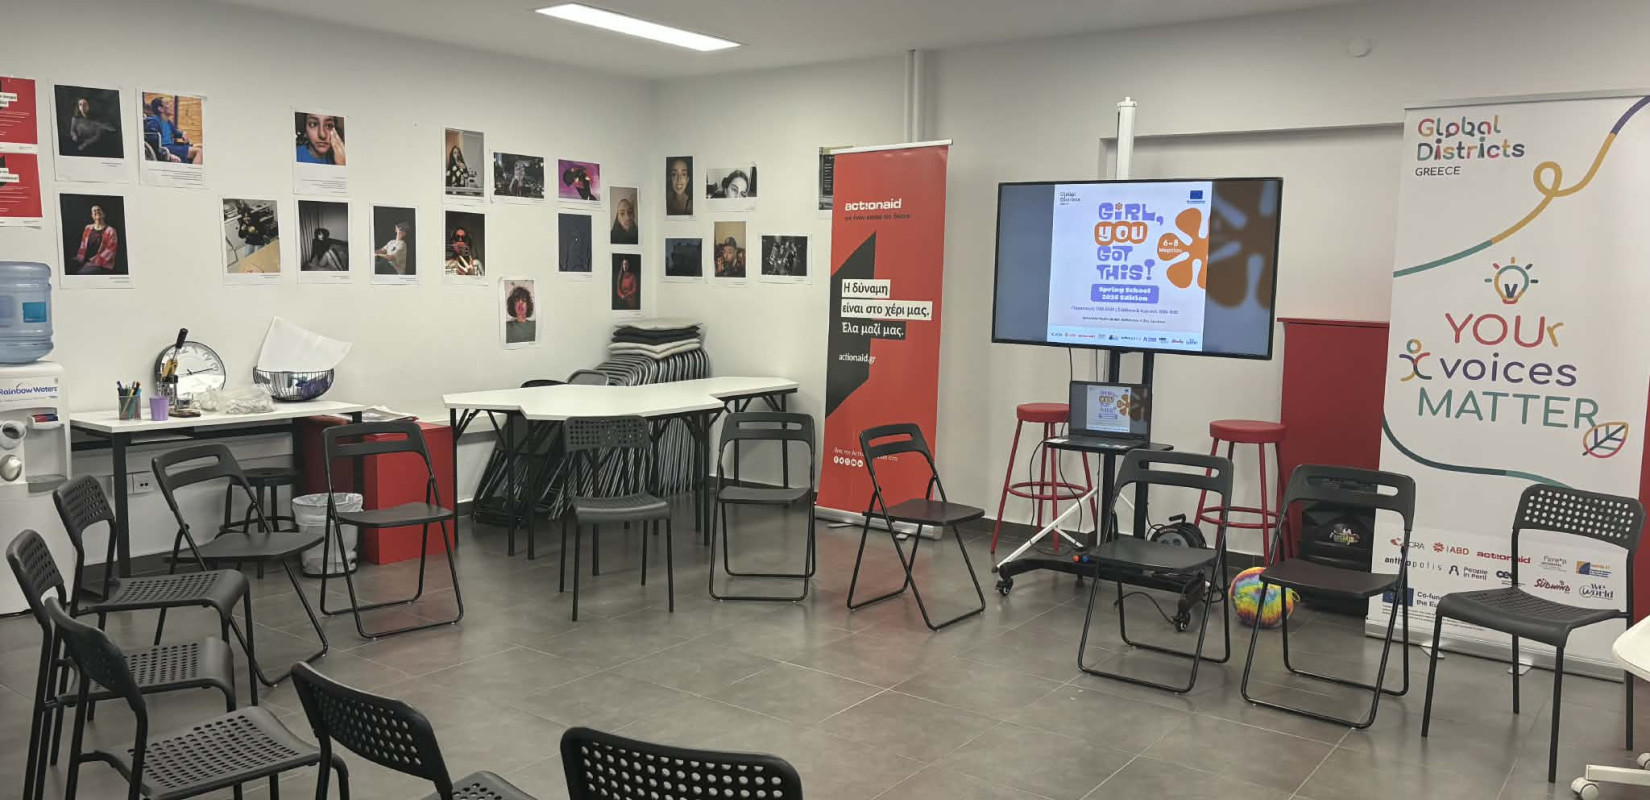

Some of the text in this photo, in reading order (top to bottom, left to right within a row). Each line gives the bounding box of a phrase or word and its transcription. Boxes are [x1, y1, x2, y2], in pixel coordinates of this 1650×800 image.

[1417, 115, 1502, 138] Global
[1417, 137, 1525, 161] Districts
[1415, 166, 1461, 177] GREECE
[852, 282, 888, 296] δύναμη
[1099, 286, 1124, 294] Spring
[842, 302, 930, 317] είναι στο χέρι μας.
[841, 321, 904, 337] Έλα μαζί μας.
[1445, 312, 1564, 348] YOUr
[838, 353, 876, 364] actionaid.gr
[1440, 352, 1577, 387] voices
[1418, 386, 1600, 429] MATTER
[1449, 546, 1470, 556] ABD
[1463, 566, 1488, 575] People
[1471, 573, 1487, 581] Peril
